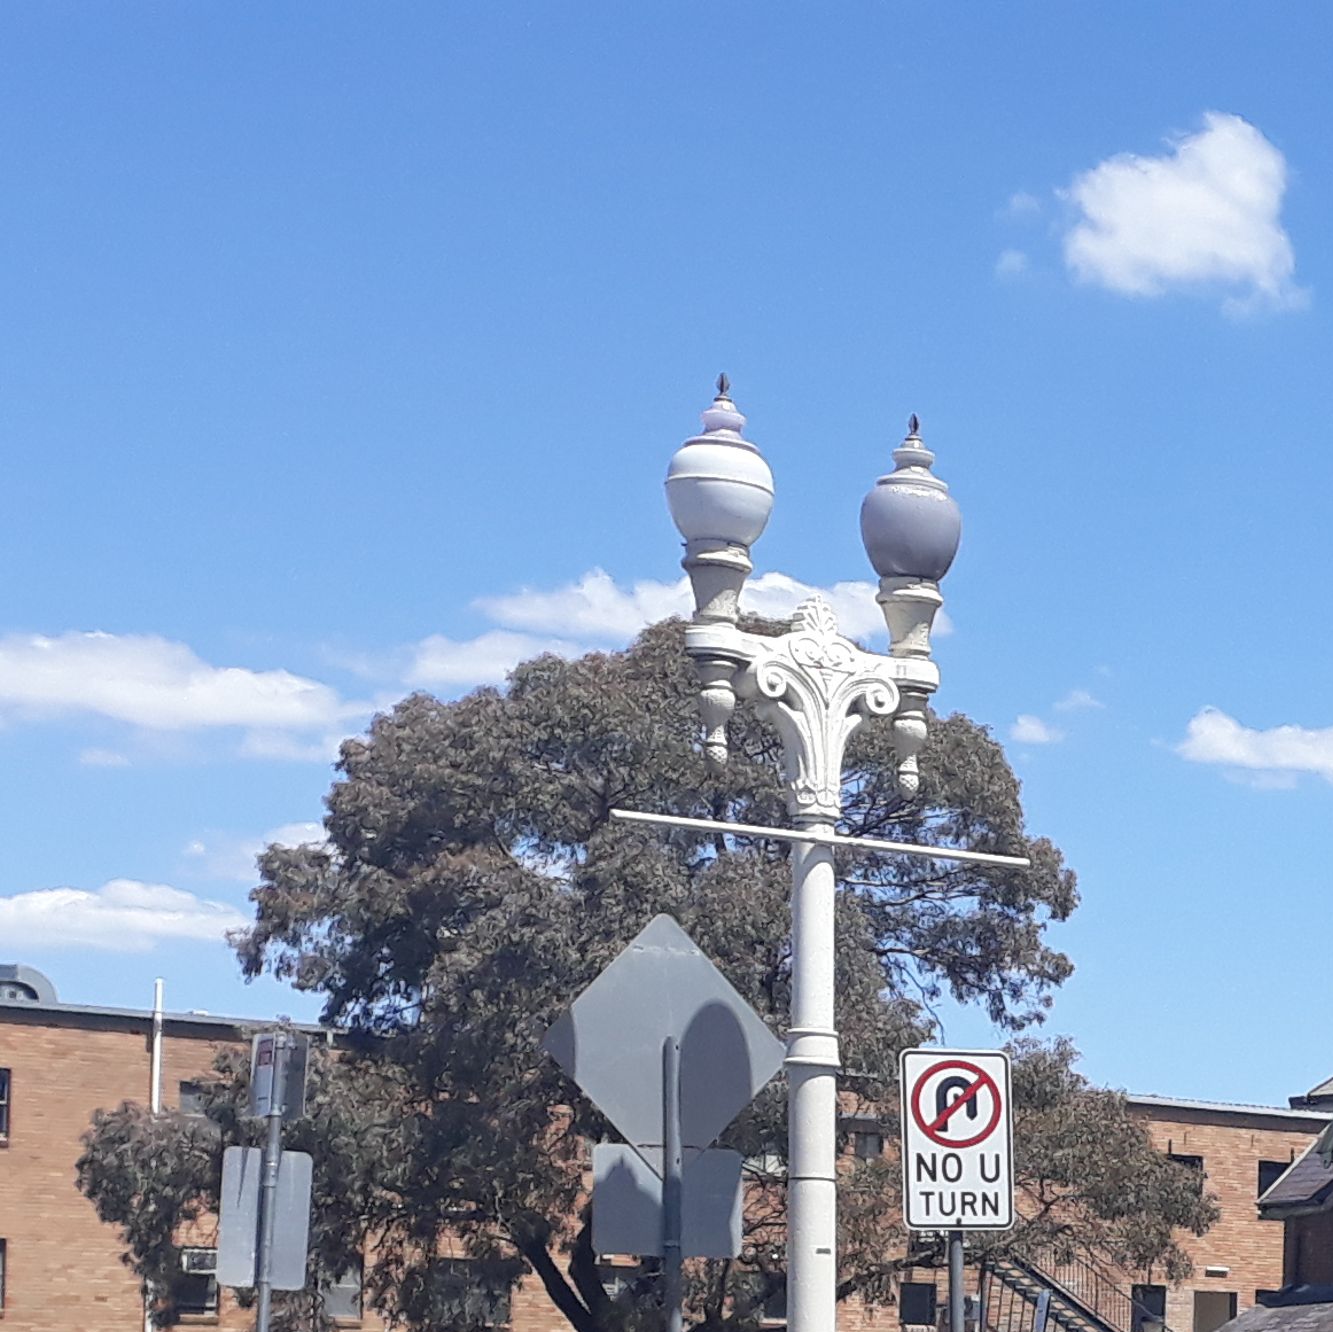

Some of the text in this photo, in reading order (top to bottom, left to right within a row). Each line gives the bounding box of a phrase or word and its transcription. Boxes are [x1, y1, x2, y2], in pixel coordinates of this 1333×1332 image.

[916, 1153, 1001, 1183] NO U
[919, 1191, 999, 1216] TURN
